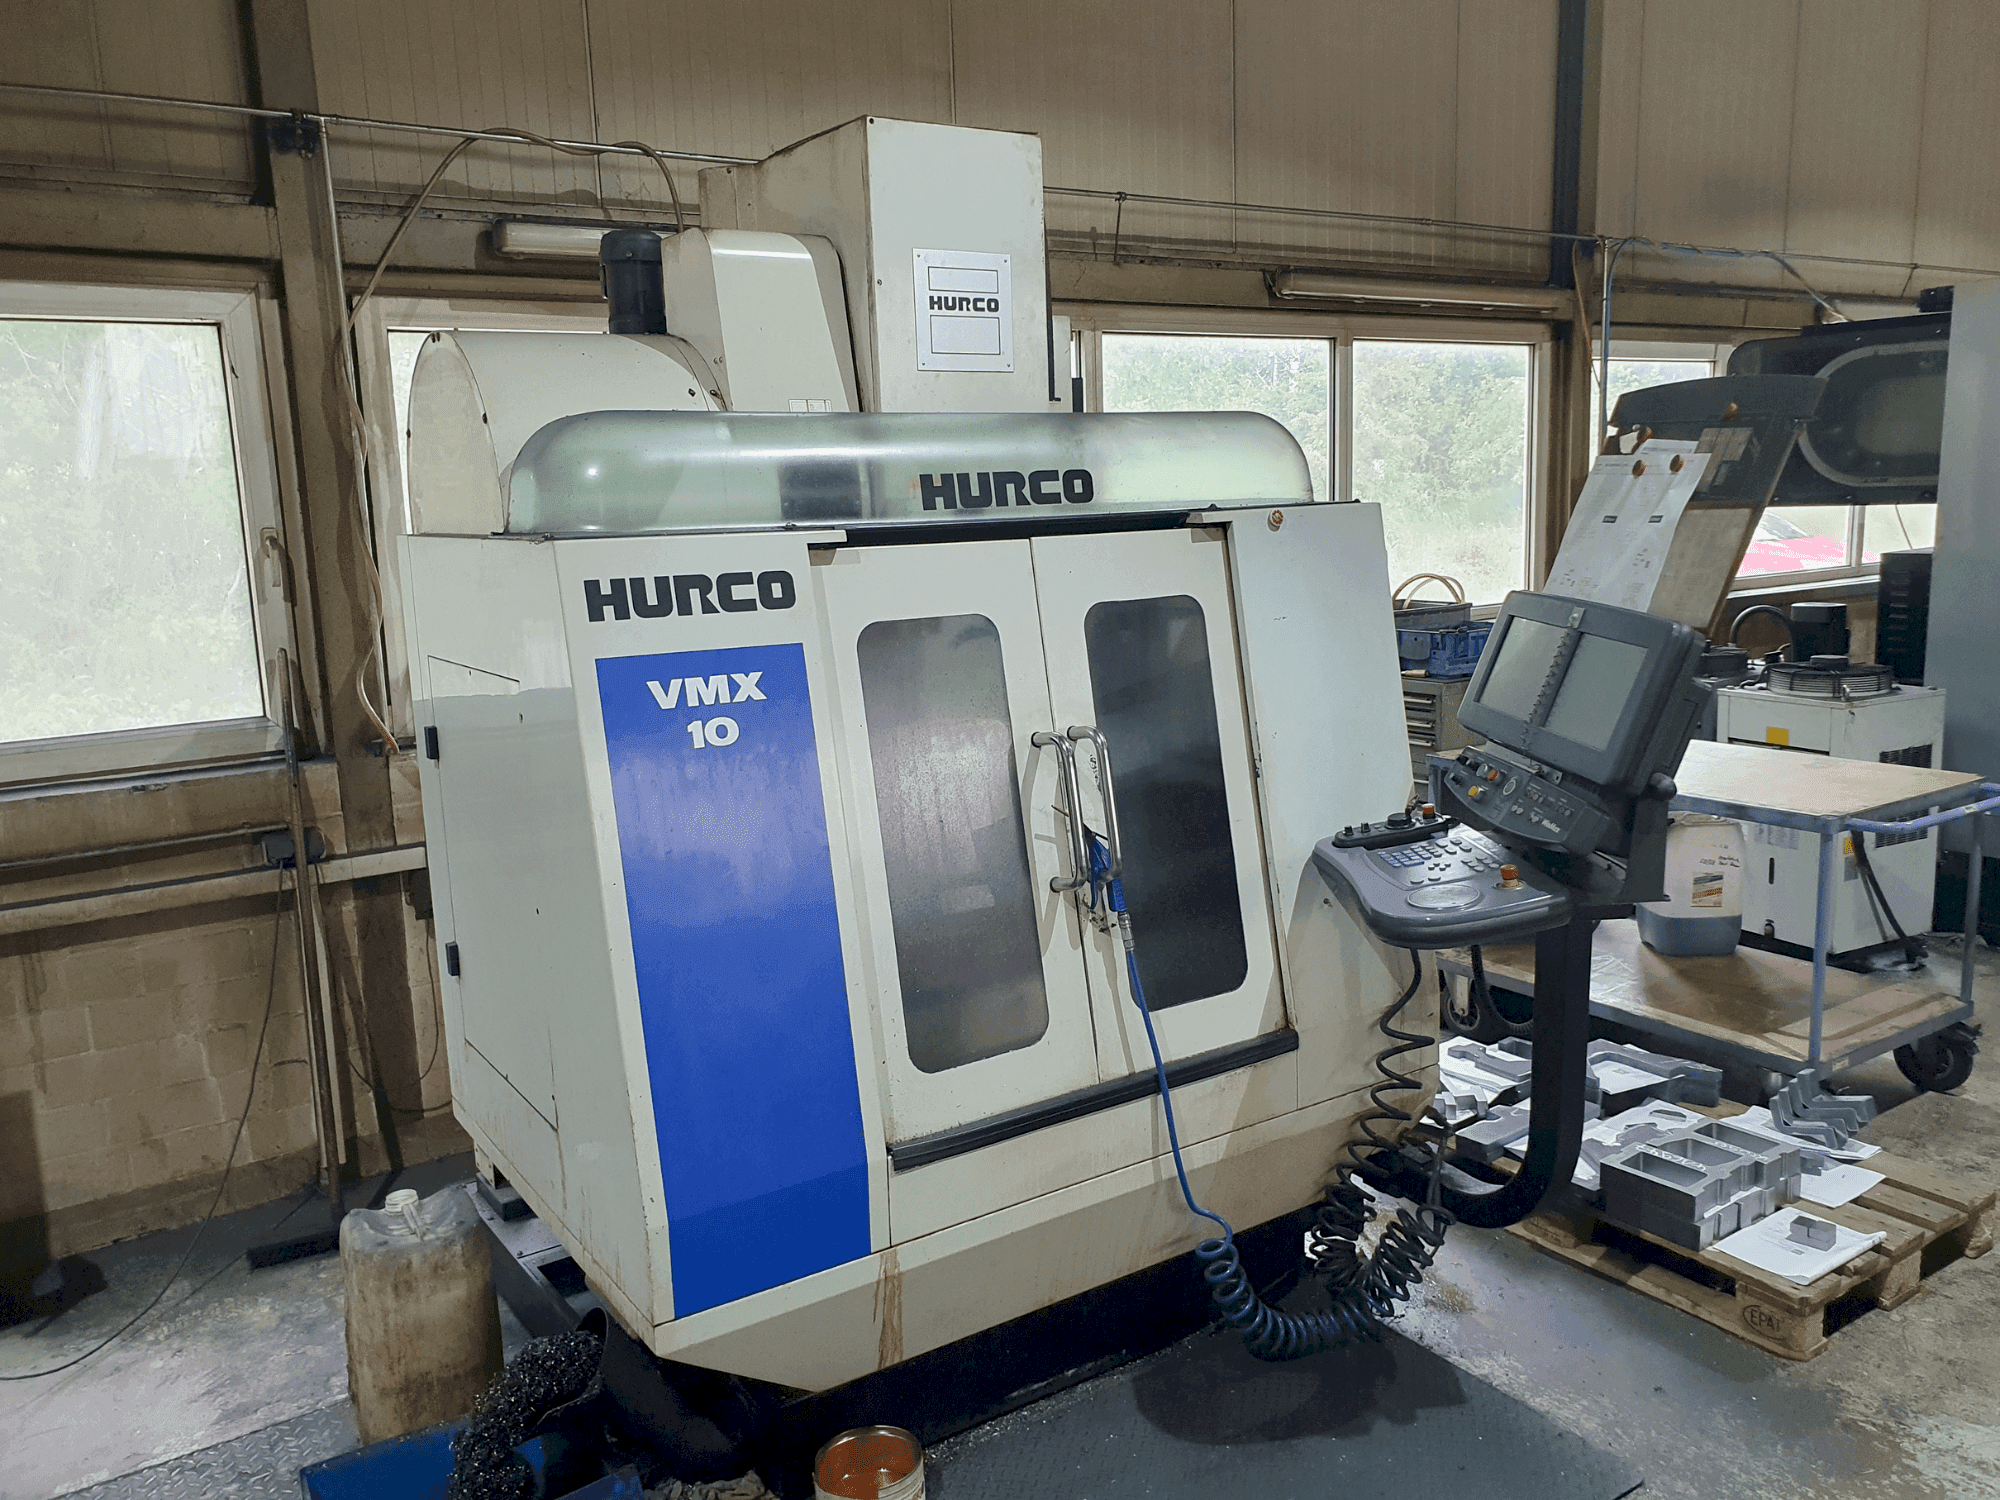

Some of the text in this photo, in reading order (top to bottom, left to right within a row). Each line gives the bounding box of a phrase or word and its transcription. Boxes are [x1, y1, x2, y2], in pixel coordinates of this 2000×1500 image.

[929, 295, 1000, 313] HURCO
[919, 469, 1094, 511] HURCO
[583, 570, 797, 623] HURCO
[646, 671, 768, 710] VMX
[686, 716, 740, 750] 10
